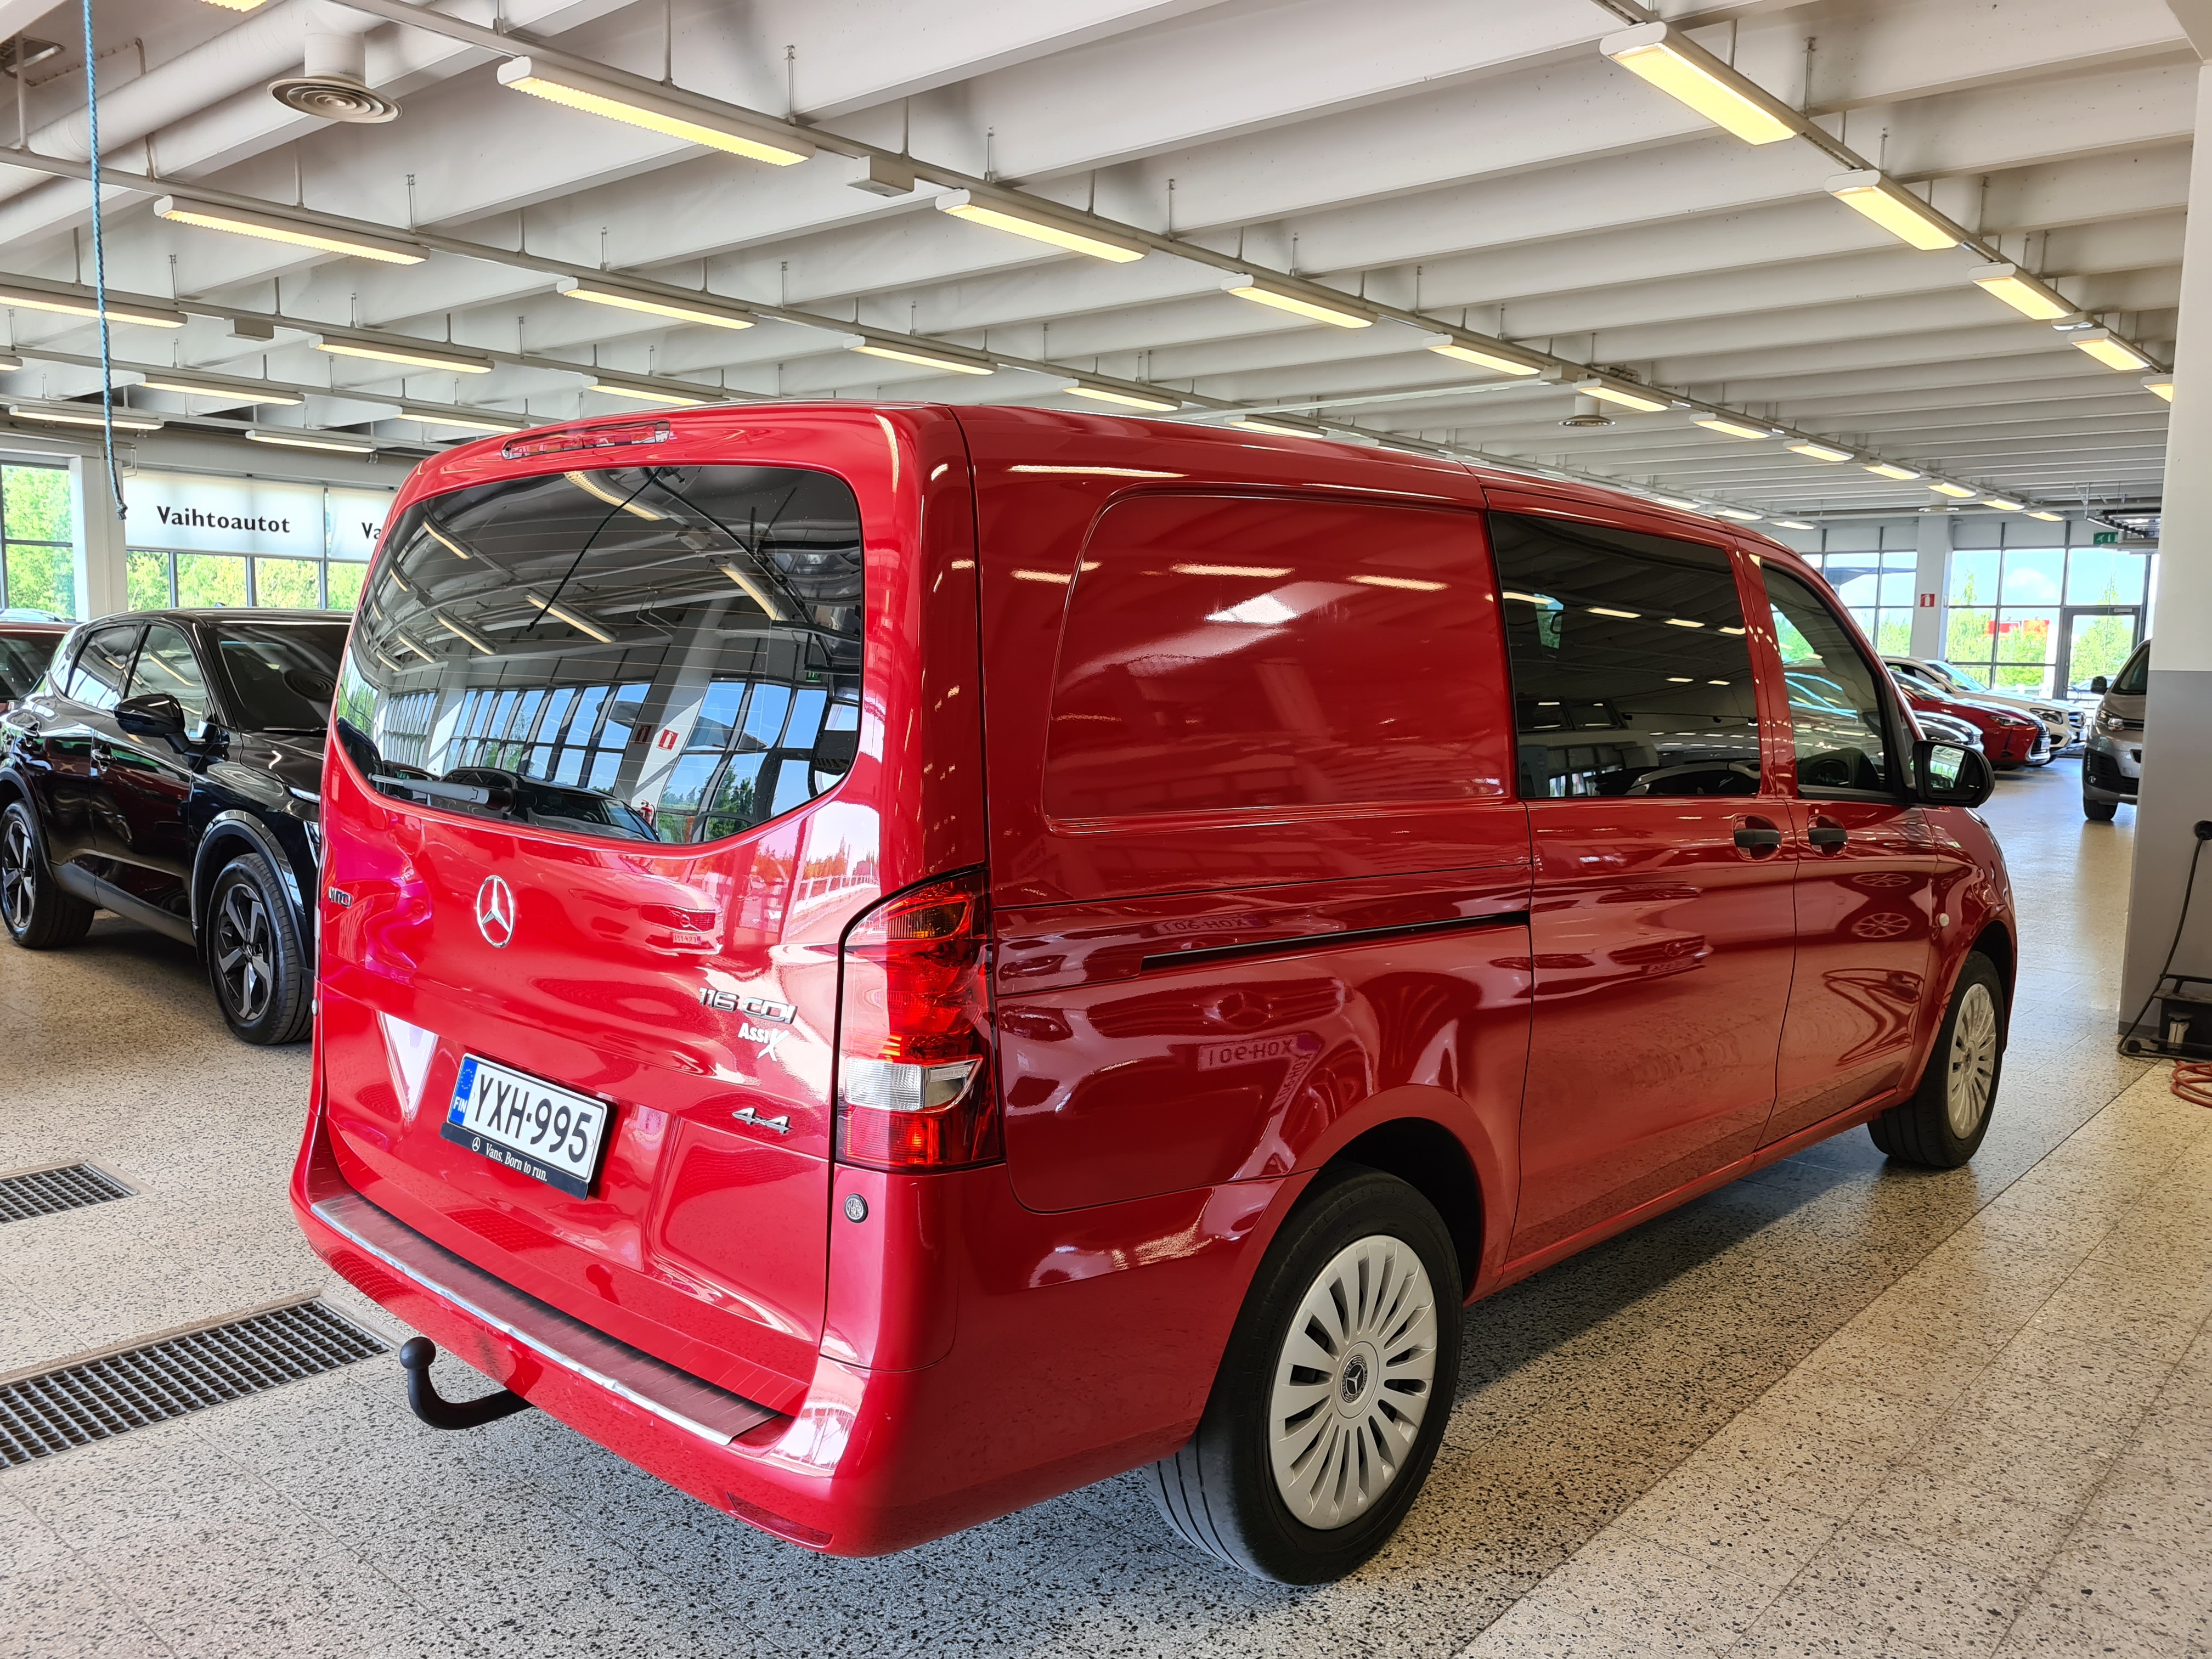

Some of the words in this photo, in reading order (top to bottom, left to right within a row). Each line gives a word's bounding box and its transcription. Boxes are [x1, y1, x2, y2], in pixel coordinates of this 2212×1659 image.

[156, 506, 290, 533] Vaihtoautot
[699, 988, 740, 1012] 116
[742, 997, 798, 1024] CDI
[453, 1097, 467, 1113] FIN
[475, 1074, 592, 1163] YXH-995
[486, 1143, 503, 1163] Vans.
[504, 1153, 522, 1171] Born
[523, 1161, 531, 1174] to
[532, 1166, 547, 1182] run.
